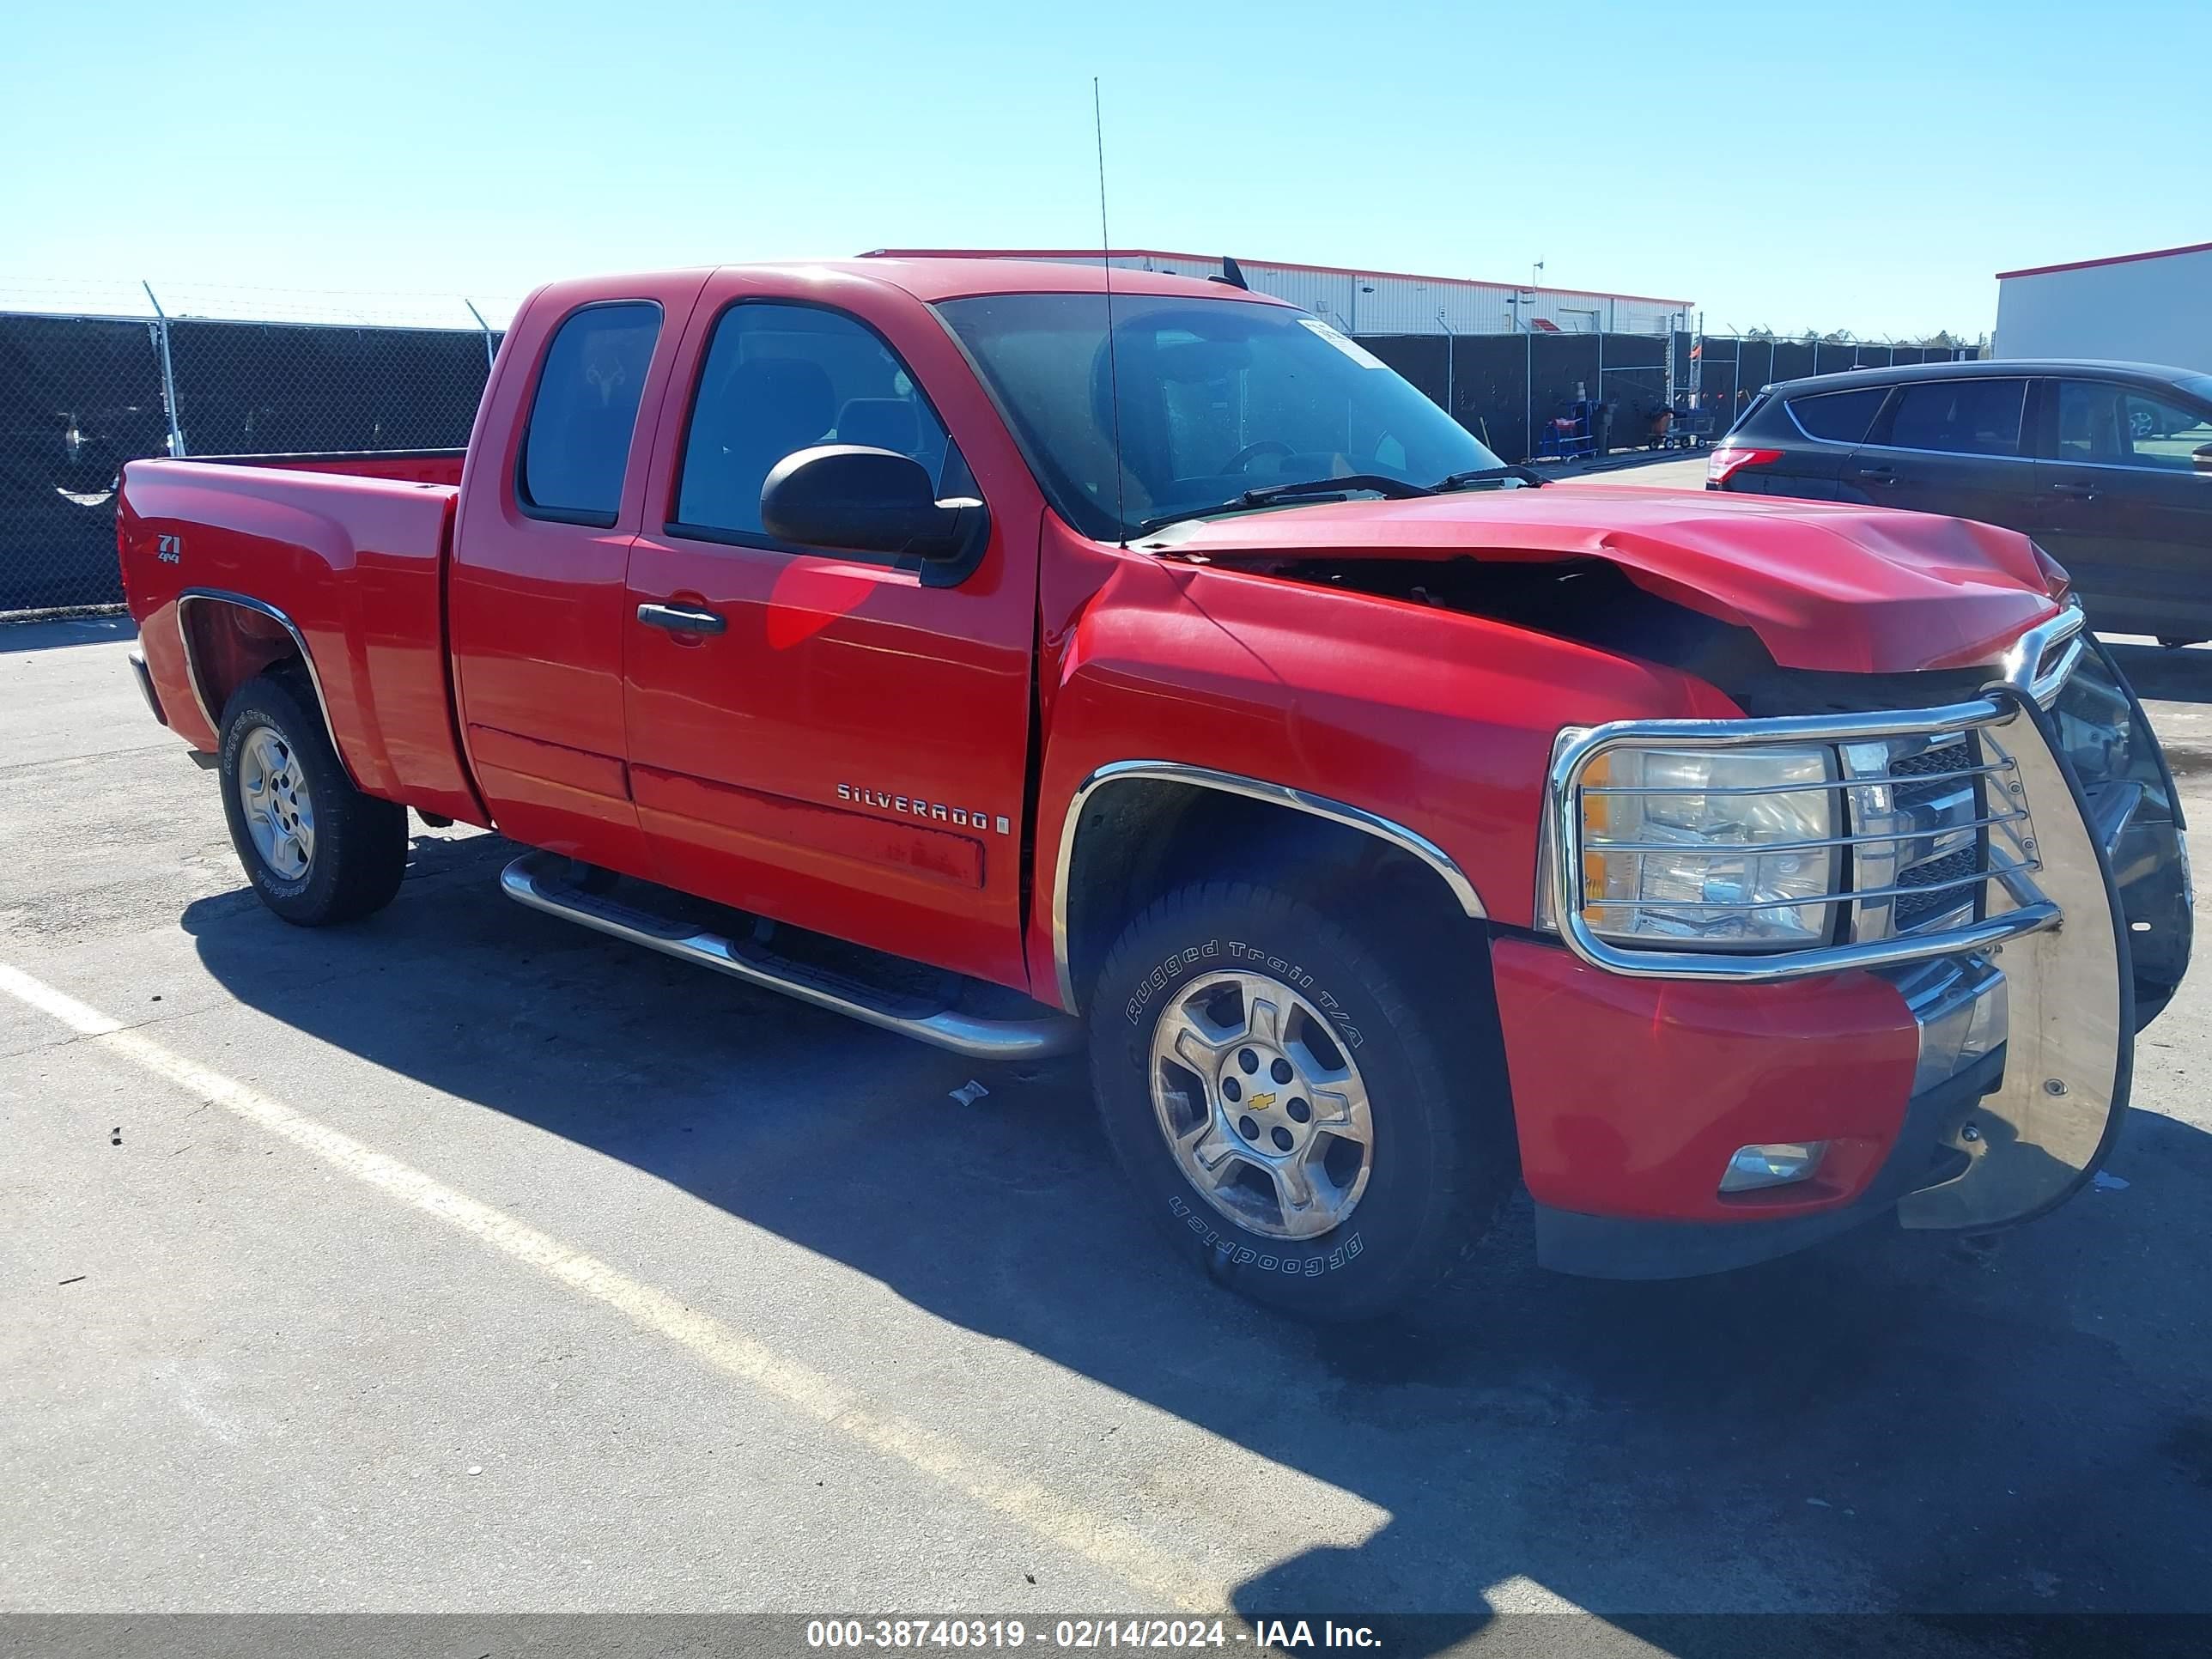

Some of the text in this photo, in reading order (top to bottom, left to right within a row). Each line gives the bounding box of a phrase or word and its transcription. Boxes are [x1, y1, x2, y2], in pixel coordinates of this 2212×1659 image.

[836, 783, 988, 830] SILVERADO
[1125, 939, 1364, 1049] Rugged Trail T/A
[1169, 1195, 1364, 1278] BFGoodrich
